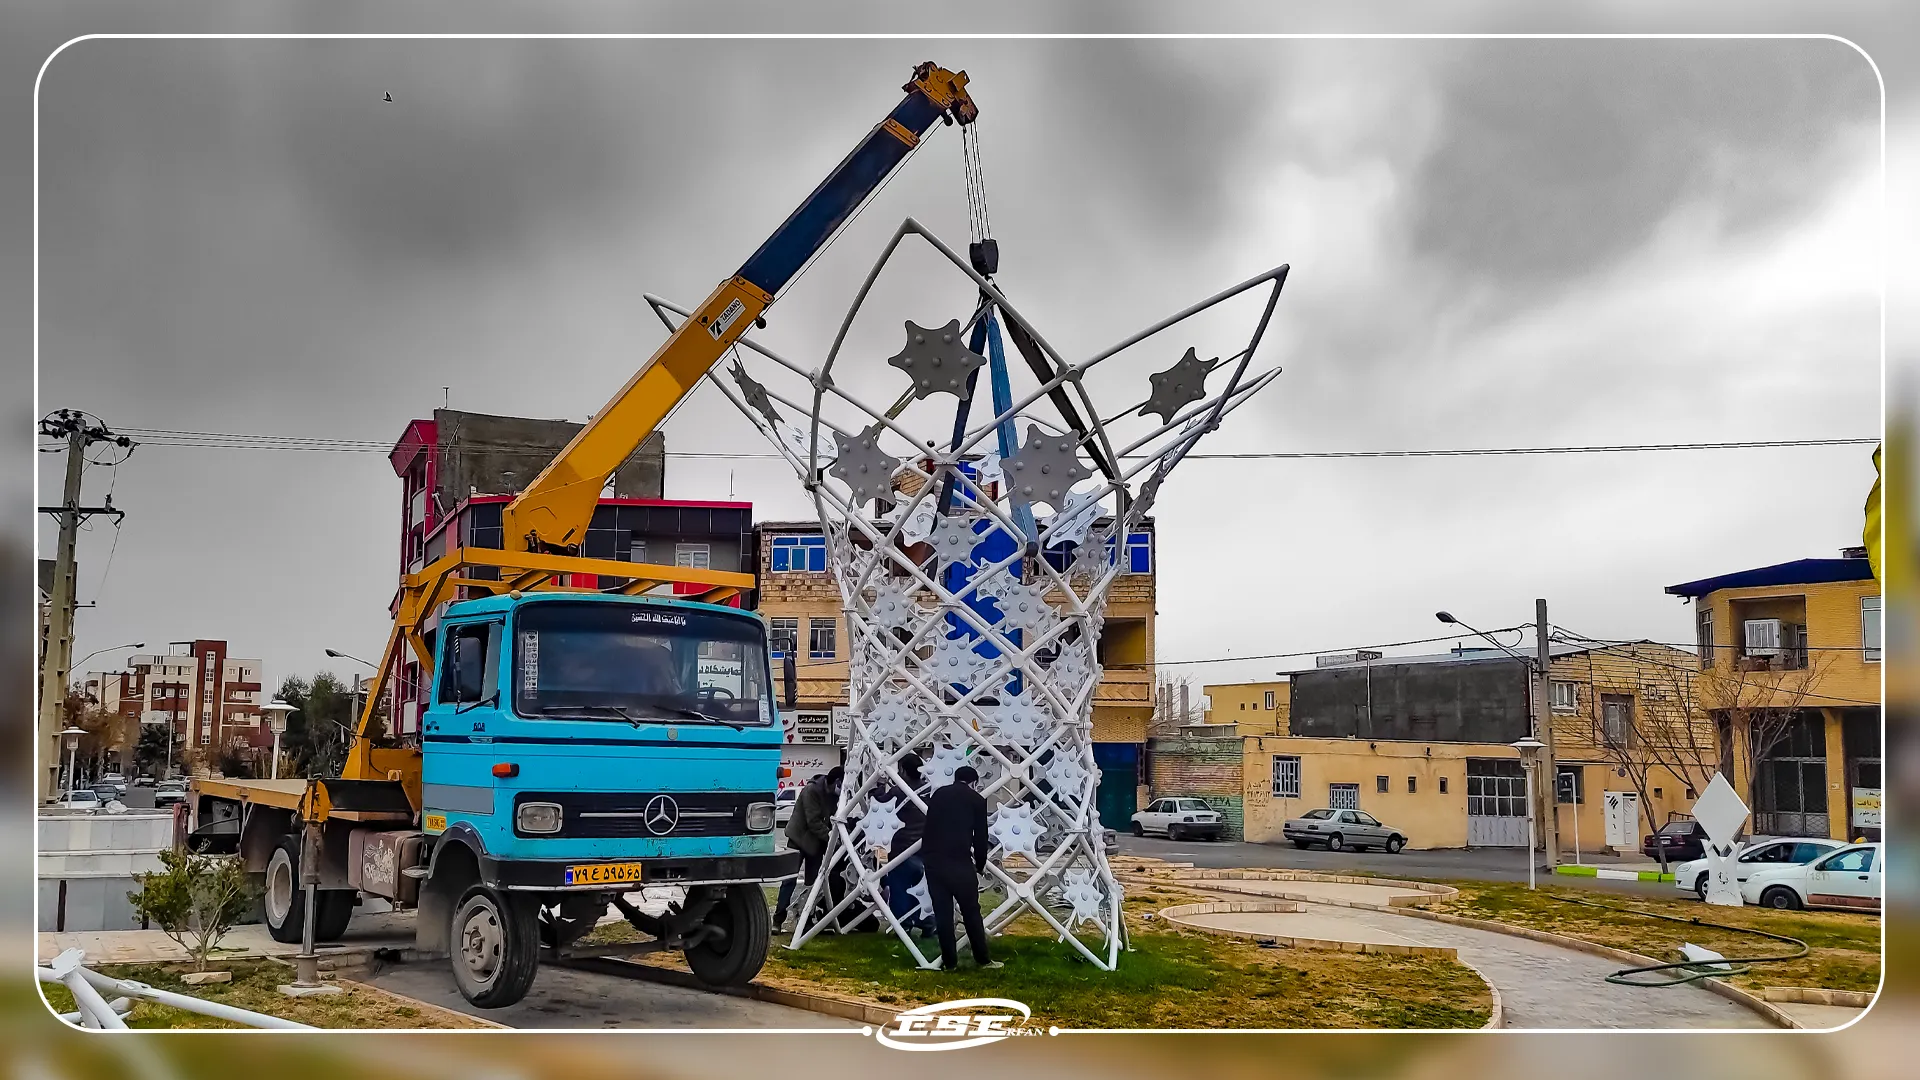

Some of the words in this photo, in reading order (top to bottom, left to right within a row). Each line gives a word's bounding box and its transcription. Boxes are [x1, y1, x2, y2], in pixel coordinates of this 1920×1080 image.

[720, 299, 741, 321] TADANO
[705, 665, 741, 677] مایشگاه
[574, 868, 588, 882] ۷۹
[604, 866, 625, 880] ۵۹۵
